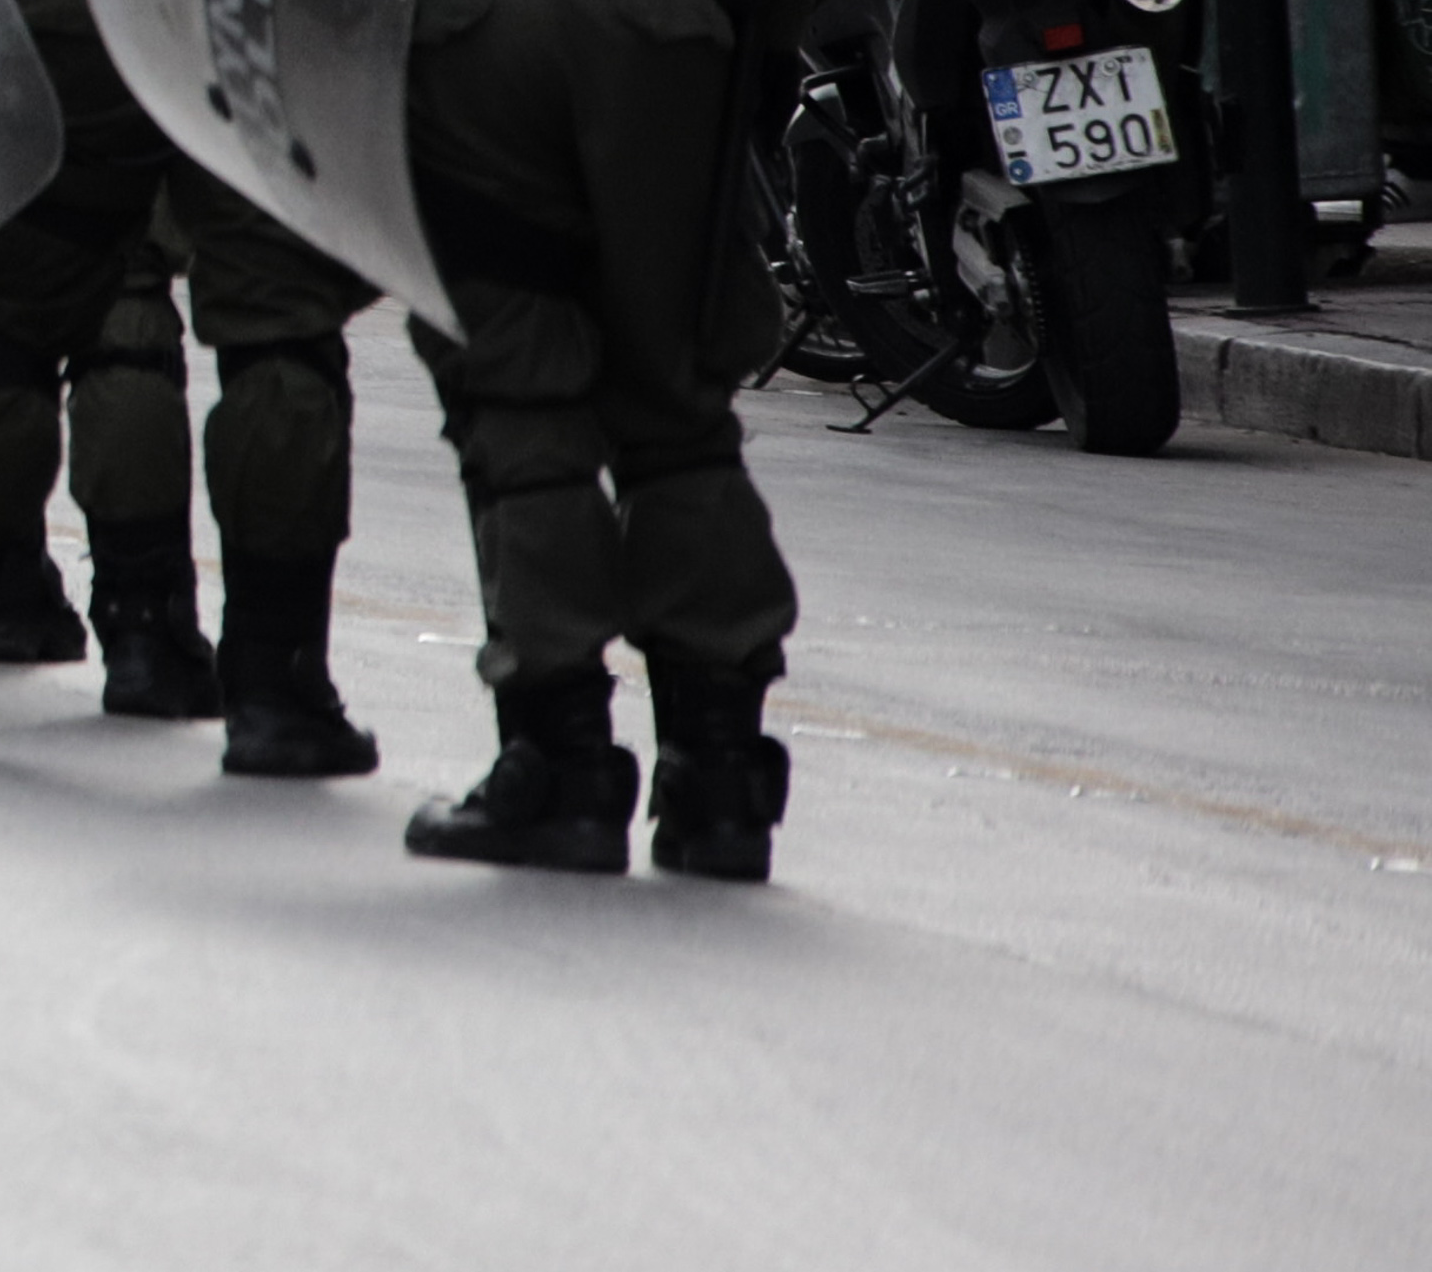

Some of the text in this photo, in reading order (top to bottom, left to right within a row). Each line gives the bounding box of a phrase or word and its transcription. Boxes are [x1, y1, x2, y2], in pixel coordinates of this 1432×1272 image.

[994, 101, 1022, 118] GR
[1035, 55, 1133, 115] ZXT
[1046, 113, 1153, 170] 590
